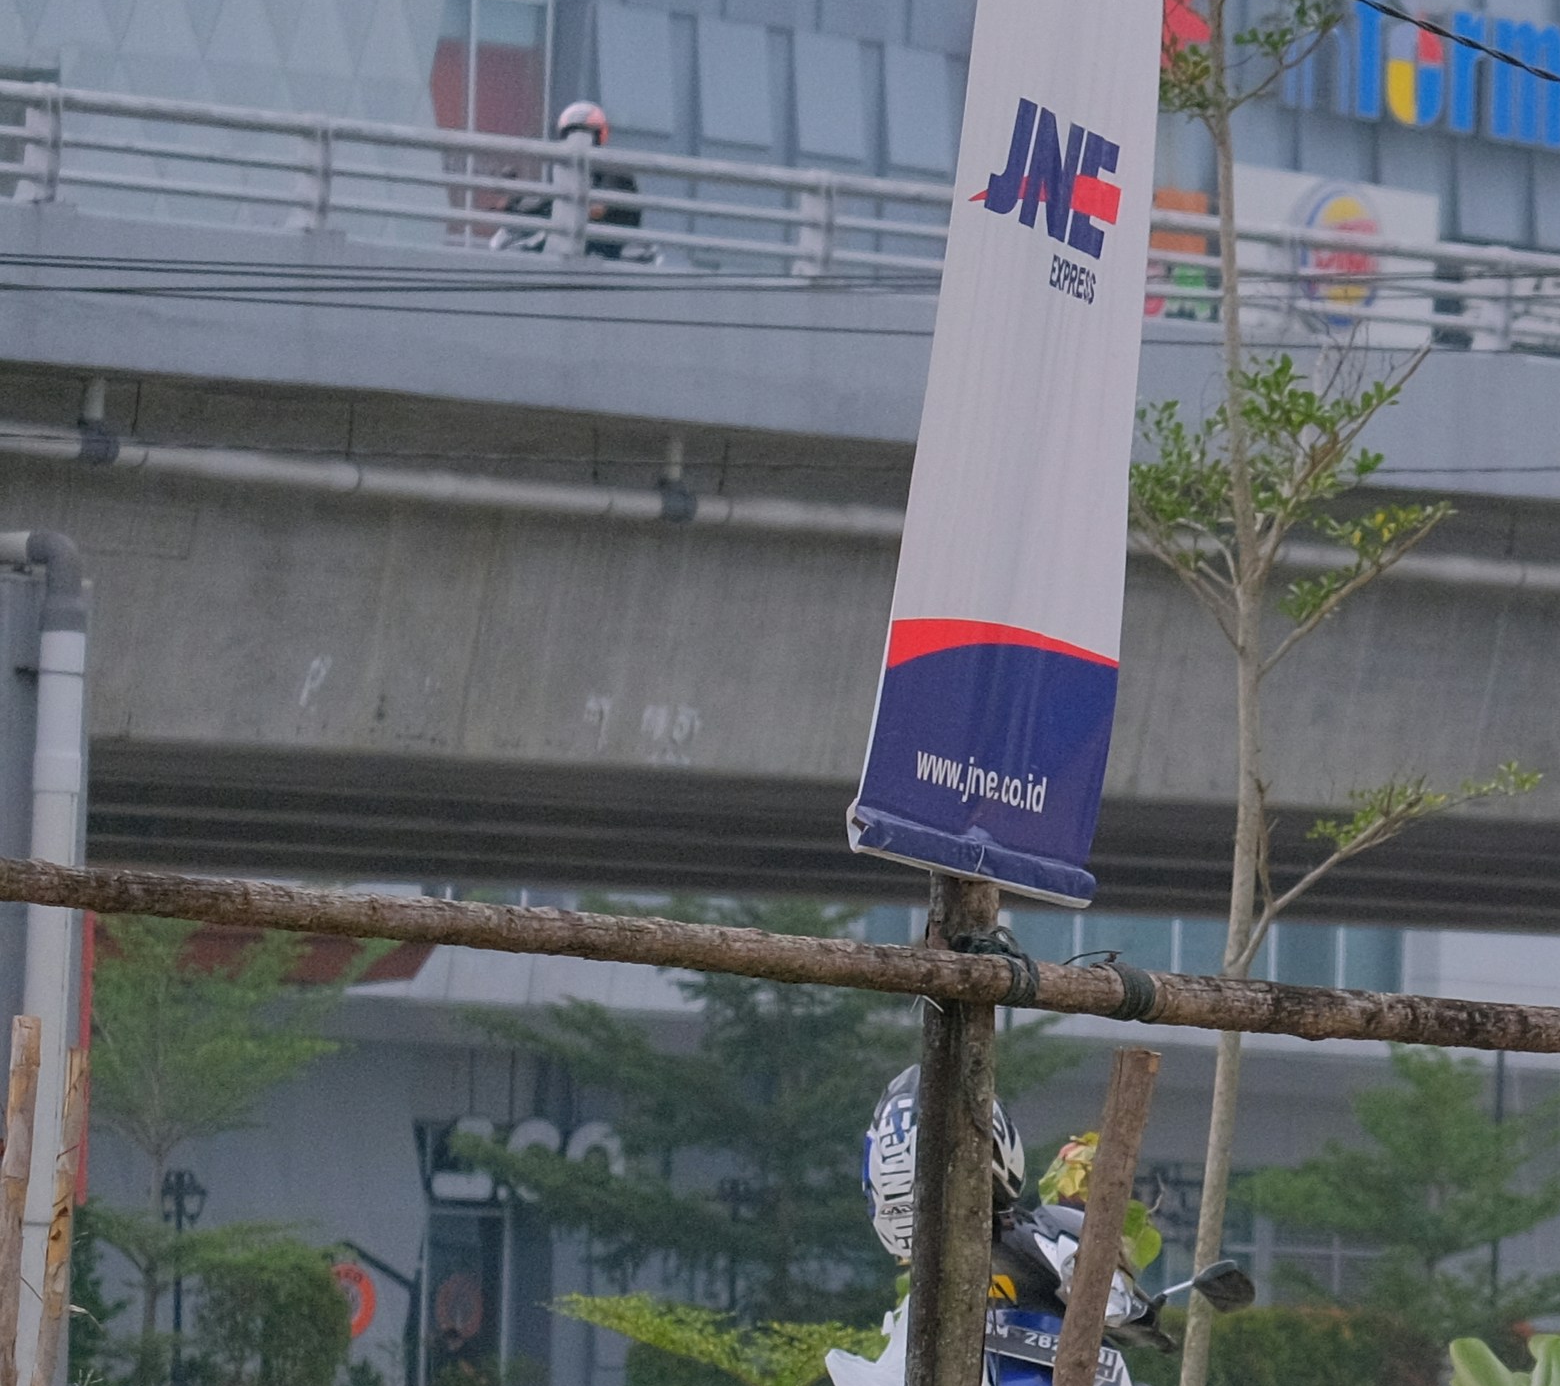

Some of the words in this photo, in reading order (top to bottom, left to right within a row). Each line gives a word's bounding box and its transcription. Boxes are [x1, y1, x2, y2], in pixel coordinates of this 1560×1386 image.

[983, 97, 1122, 260] JNE
[1050, 254, 1097, 304] EXPRESS
[916, 750, 1048, 814] www.jne.co.id
